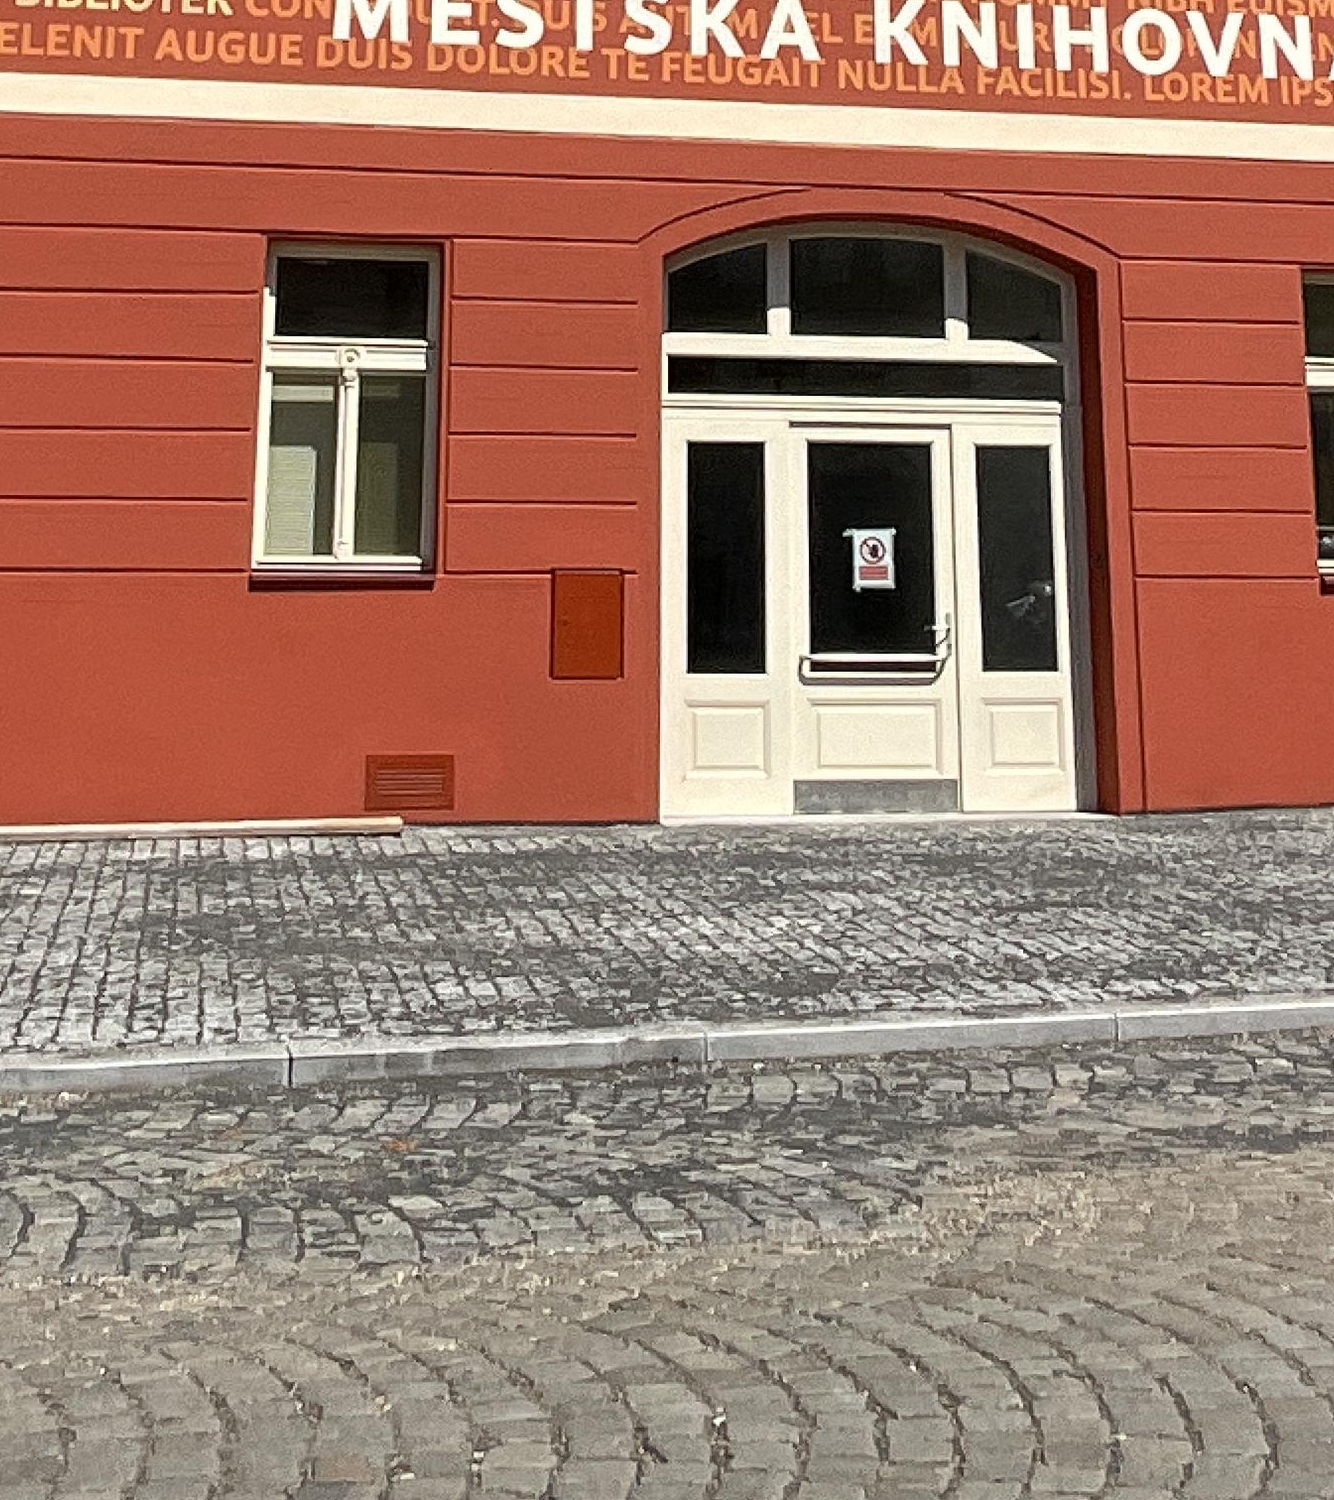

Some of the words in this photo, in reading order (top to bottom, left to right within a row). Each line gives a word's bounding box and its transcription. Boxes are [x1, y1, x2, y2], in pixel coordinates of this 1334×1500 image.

[153, 30, 303, 65] AUGUE
[315, 35, 412, 72] DUIS
[427, 42, 590, 79] DOLORE
[599, 48, 649, 81] TE
[660, 52, 825, 89] FEUGAIT
[839, 60, 965, 94] NULLA
[977, 65, 1132, 100] FACILISI.
[1143, 71, 1268, 104] LOREM
